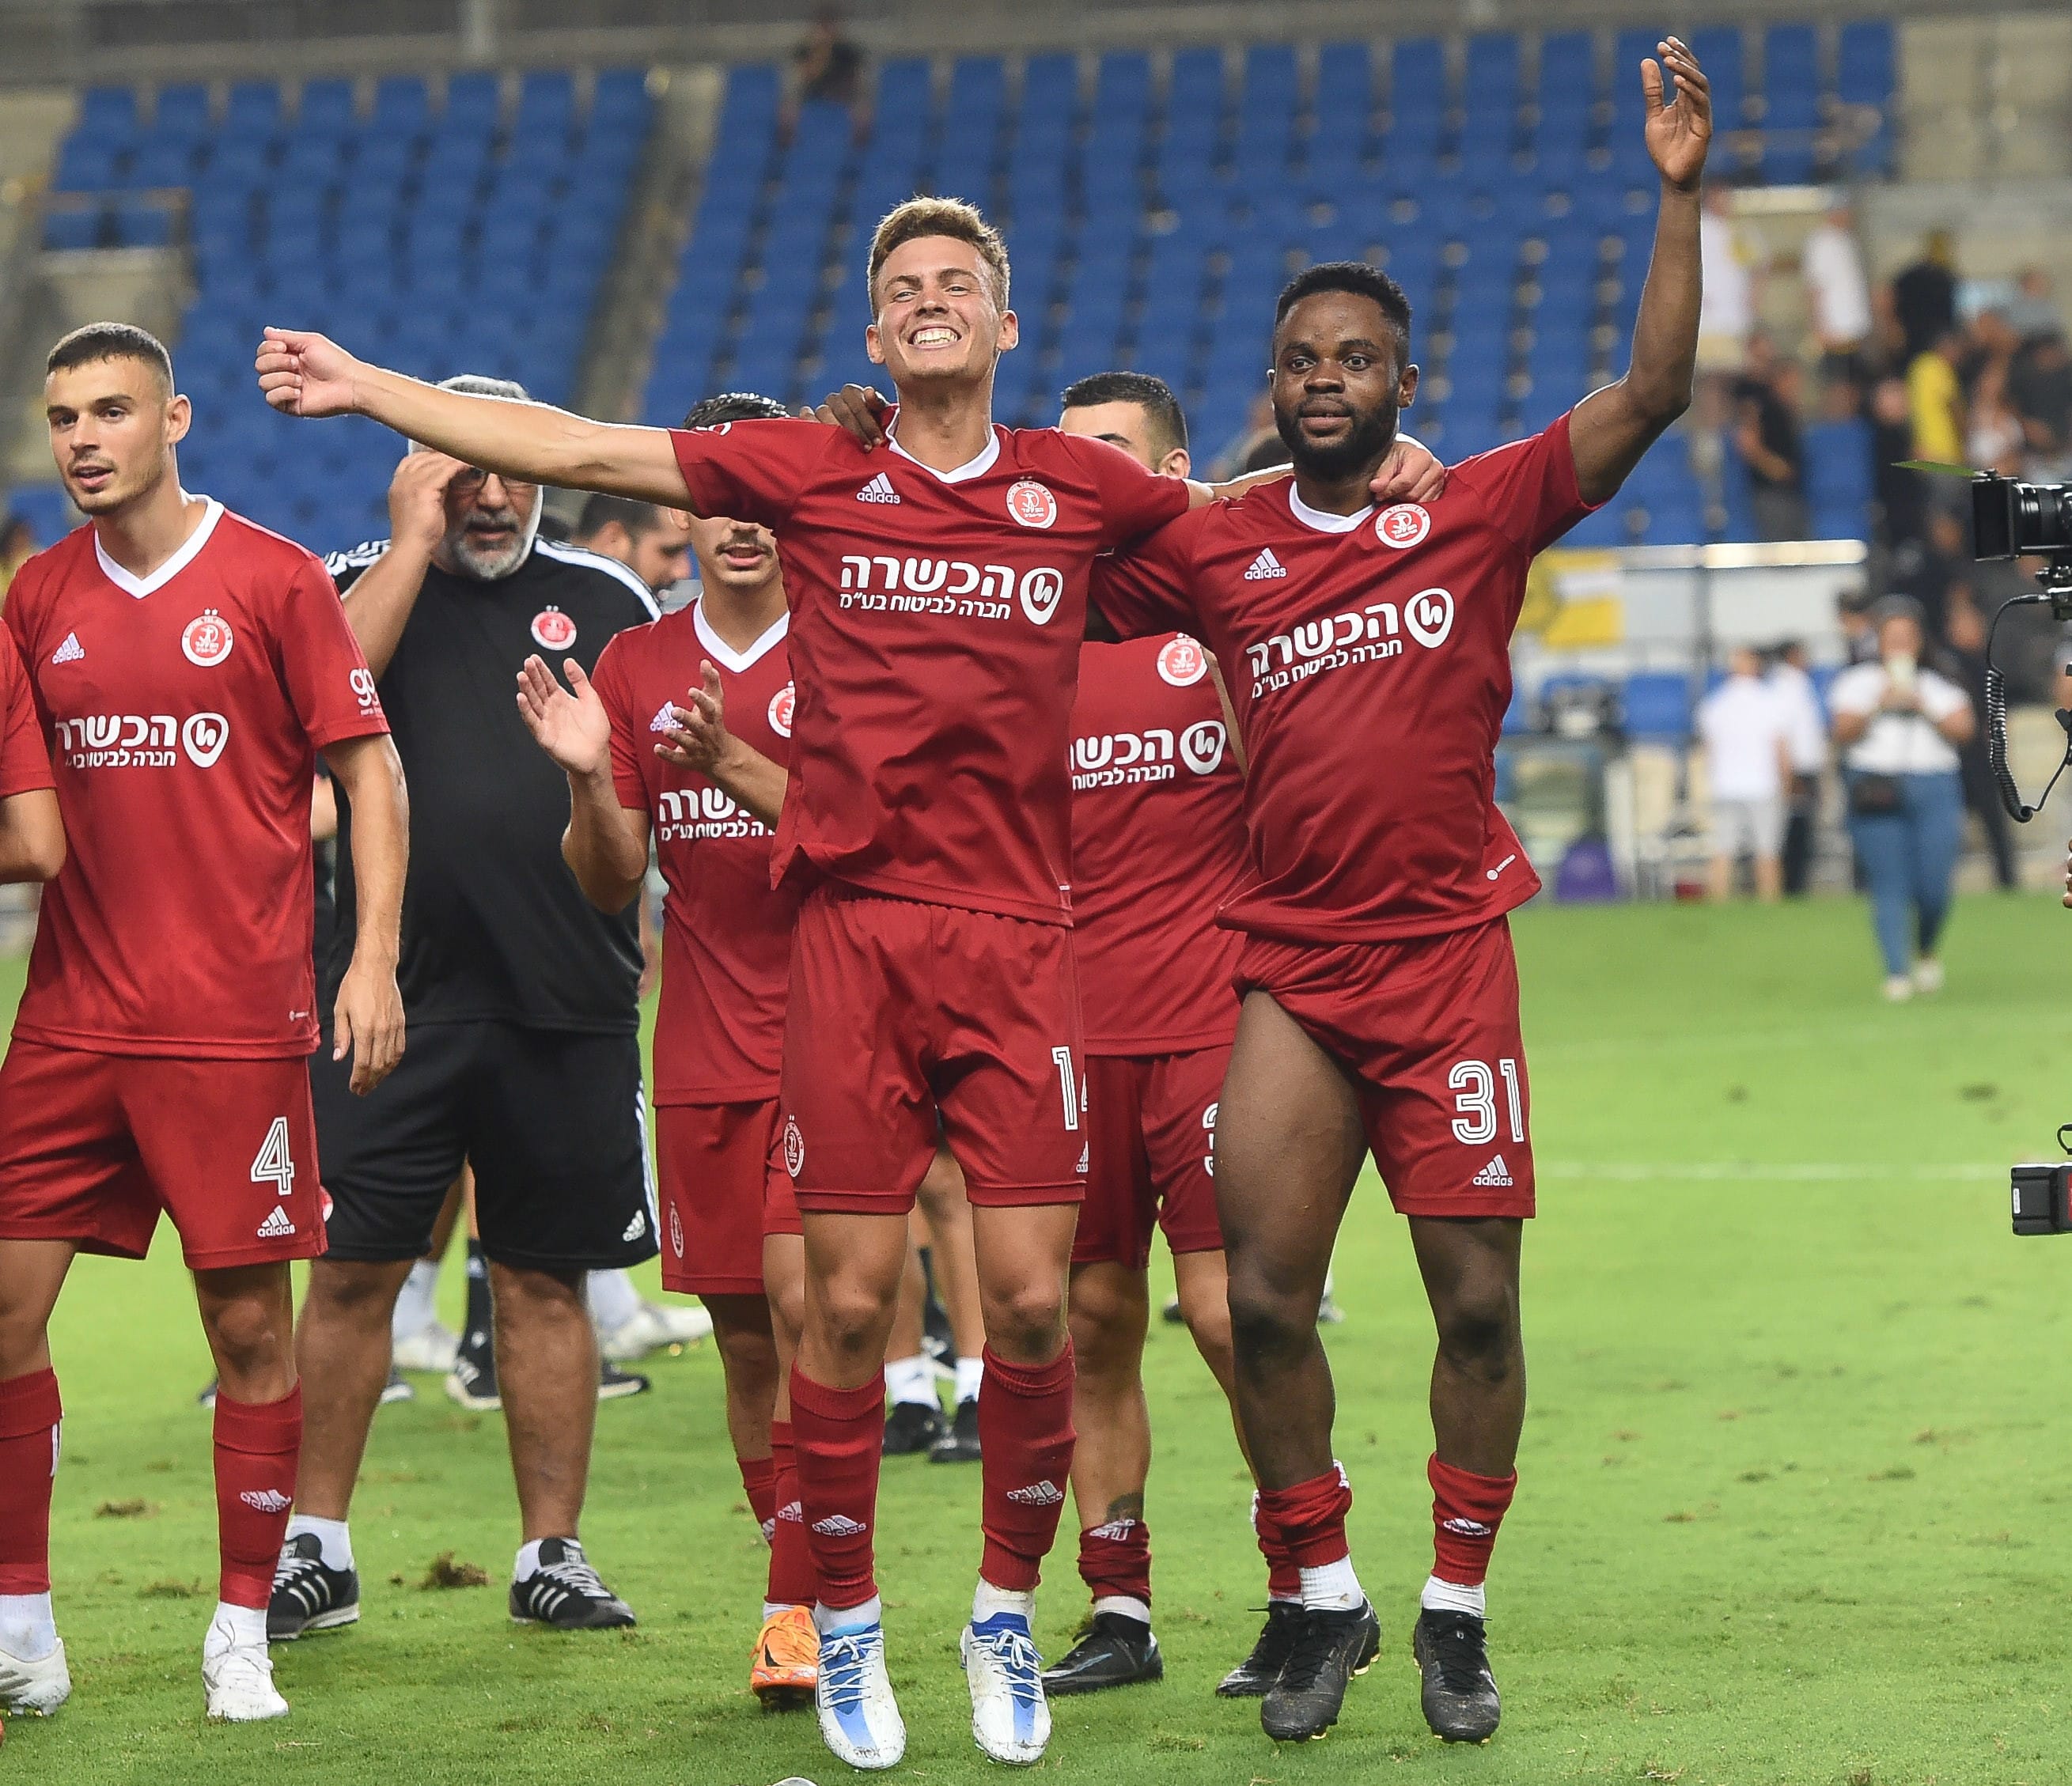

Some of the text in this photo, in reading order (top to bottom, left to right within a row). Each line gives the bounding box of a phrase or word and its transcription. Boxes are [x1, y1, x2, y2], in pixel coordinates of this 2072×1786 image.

[856, 491, 901, 505] adidas
[840, 556, 1016, 599] הכשרה
[1244, 566, 1287, 581] adidas
[889, 594, 956, 614] לביטוח
[958, 600, 1011, 620] חברה
[1352, 639, 1403, 664] חברה
[1291, 649, 1349, 683] לביטוח
[133, 751, 176, 767] חברה
[1072, 764, 1176, 791] חברה לביטוח
[695, 819, 748, 838] לביטוח
[1051, 1046, 1088, 1131] 1
[1448, 1058, 1525, 1145] 31
[250, 1116, 296, 1196] 4
[1472, 1174, 1513, 1186] adidas
[256, 1224, 296, 1238] adidas
